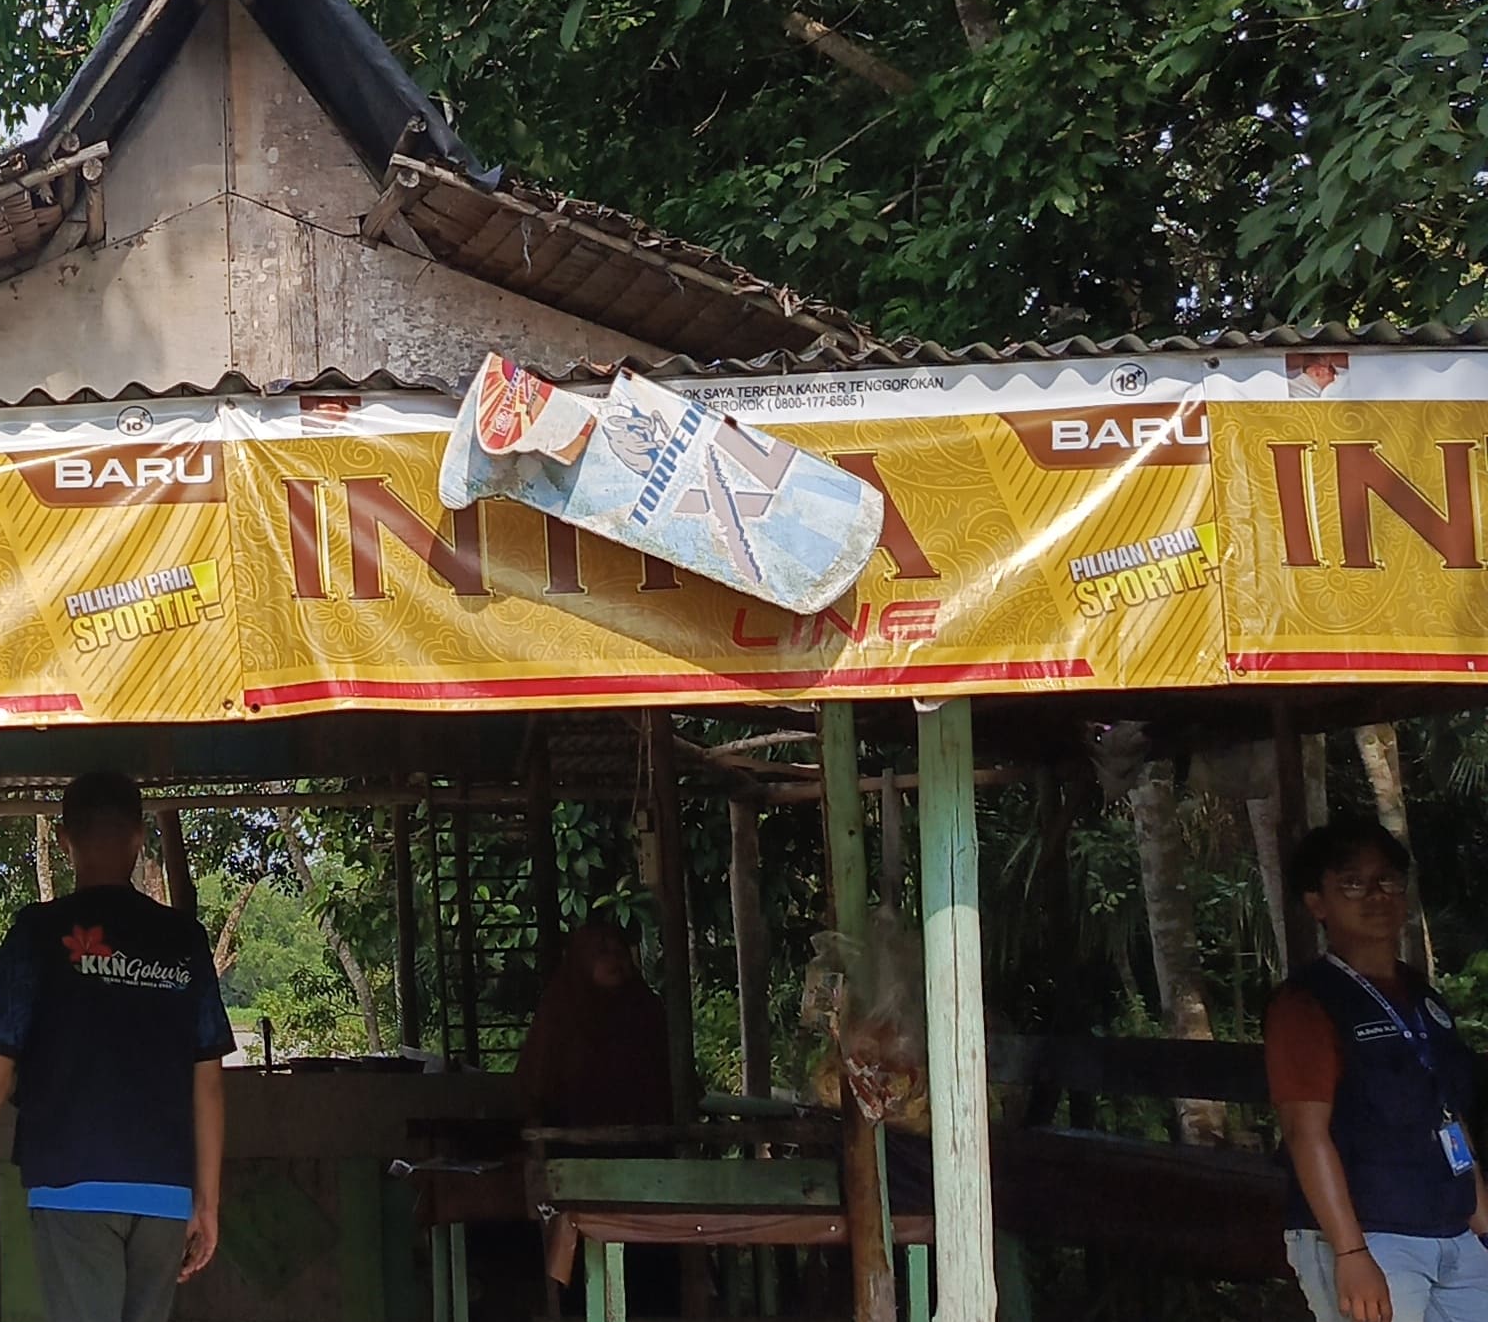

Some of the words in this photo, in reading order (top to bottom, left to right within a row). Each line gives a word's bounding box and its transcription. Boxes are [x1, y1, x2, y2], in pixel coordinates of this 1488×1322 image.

[703, 388, 734, 399] SAYA
[737, 385, 793, 398] TERKENA
[796, 382, 846, 395] KANKER
[848, 377, 944, 393] TENGGOROKAN
[775, 395, 857, 409] 0800-177-6565
[1051, 414, 1210, 450] BARU
[55, 454, 213, 489] BARU
[1267, 434, 1488, 570] IN
[281, 449, 941, 600] INA
[1068, 542, 1147, 582] PILIHAN
[1147, 527, 1200, 559] PRIA
[65, 579, 144, 617] PILIHAN
[145, 565, 195, 595] PRIA
[731, 600, 941, 647] LINE
[81, 955, 126, 977] KKN
